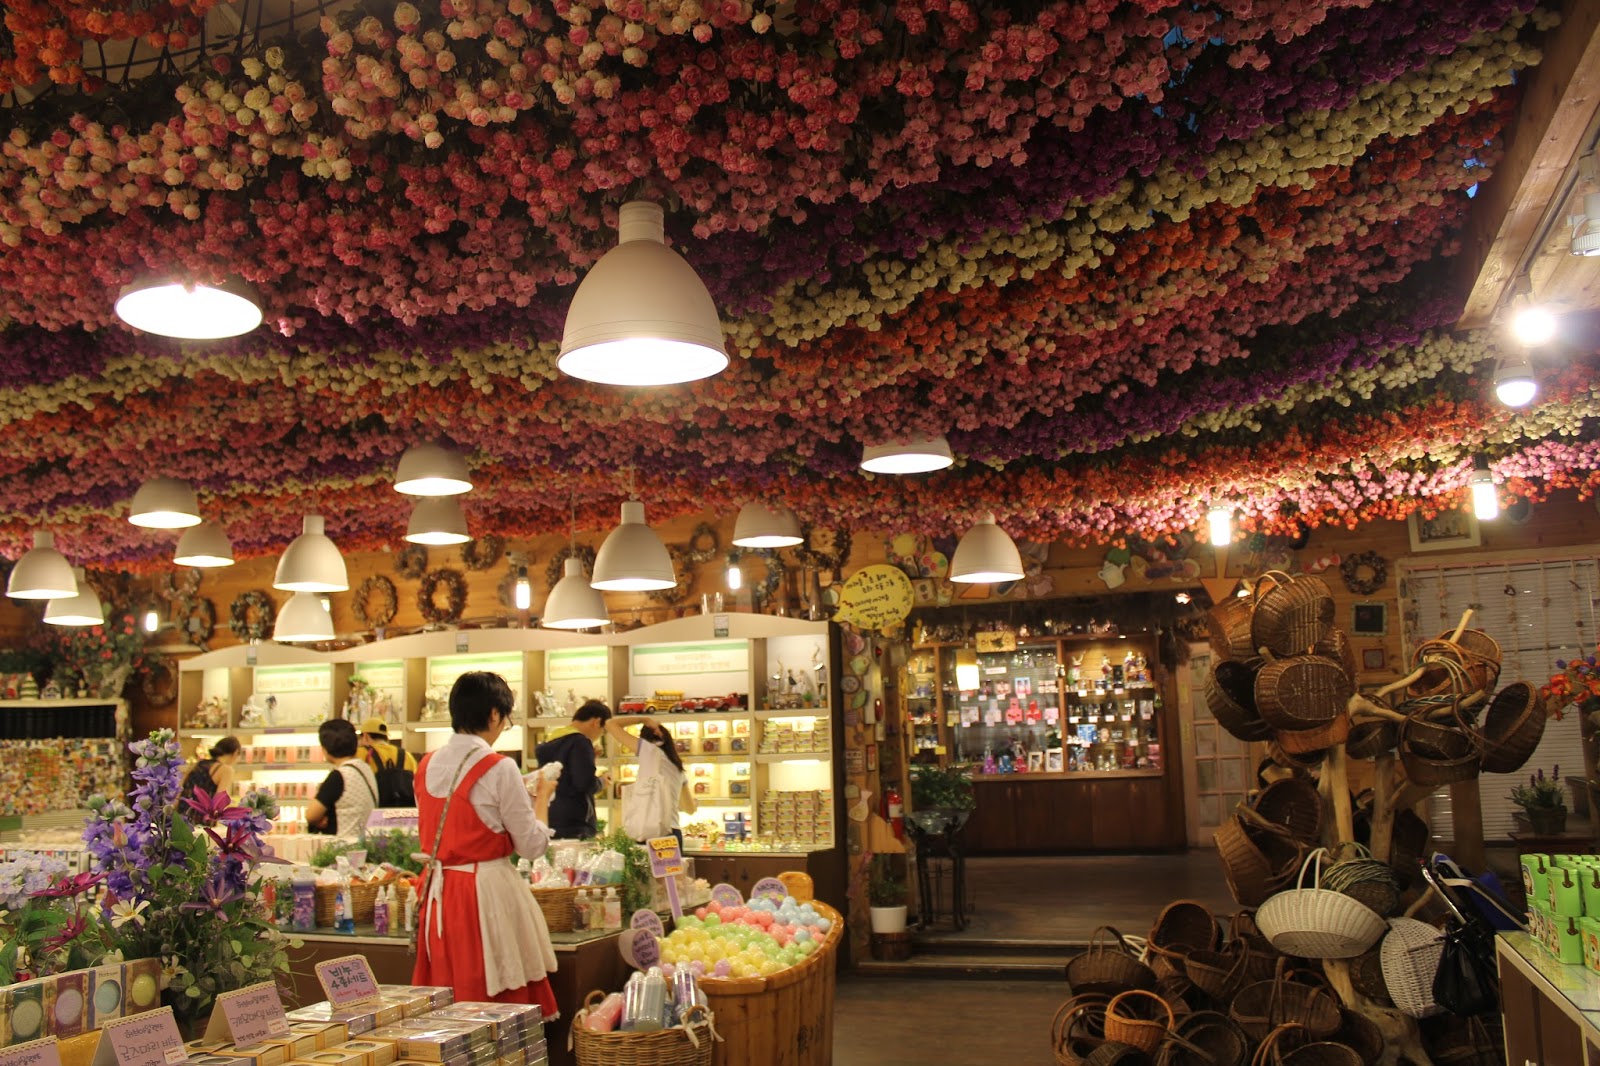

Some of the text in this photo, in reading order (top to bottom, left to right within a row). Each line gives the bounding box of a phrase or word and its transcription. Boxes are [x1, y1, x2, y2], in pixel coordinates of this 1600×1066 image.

[328, 965, 352, 977] 비누
[265, 1004, 280, 1016] 비누
[124, 1023, 165, 1039] 허브아일랜드
[118, 1041, 161, 1062] 로즈마리
[162, 1036, 179, 1048] 비누
[4, 1053, 43, 1066] 브아일랜드
